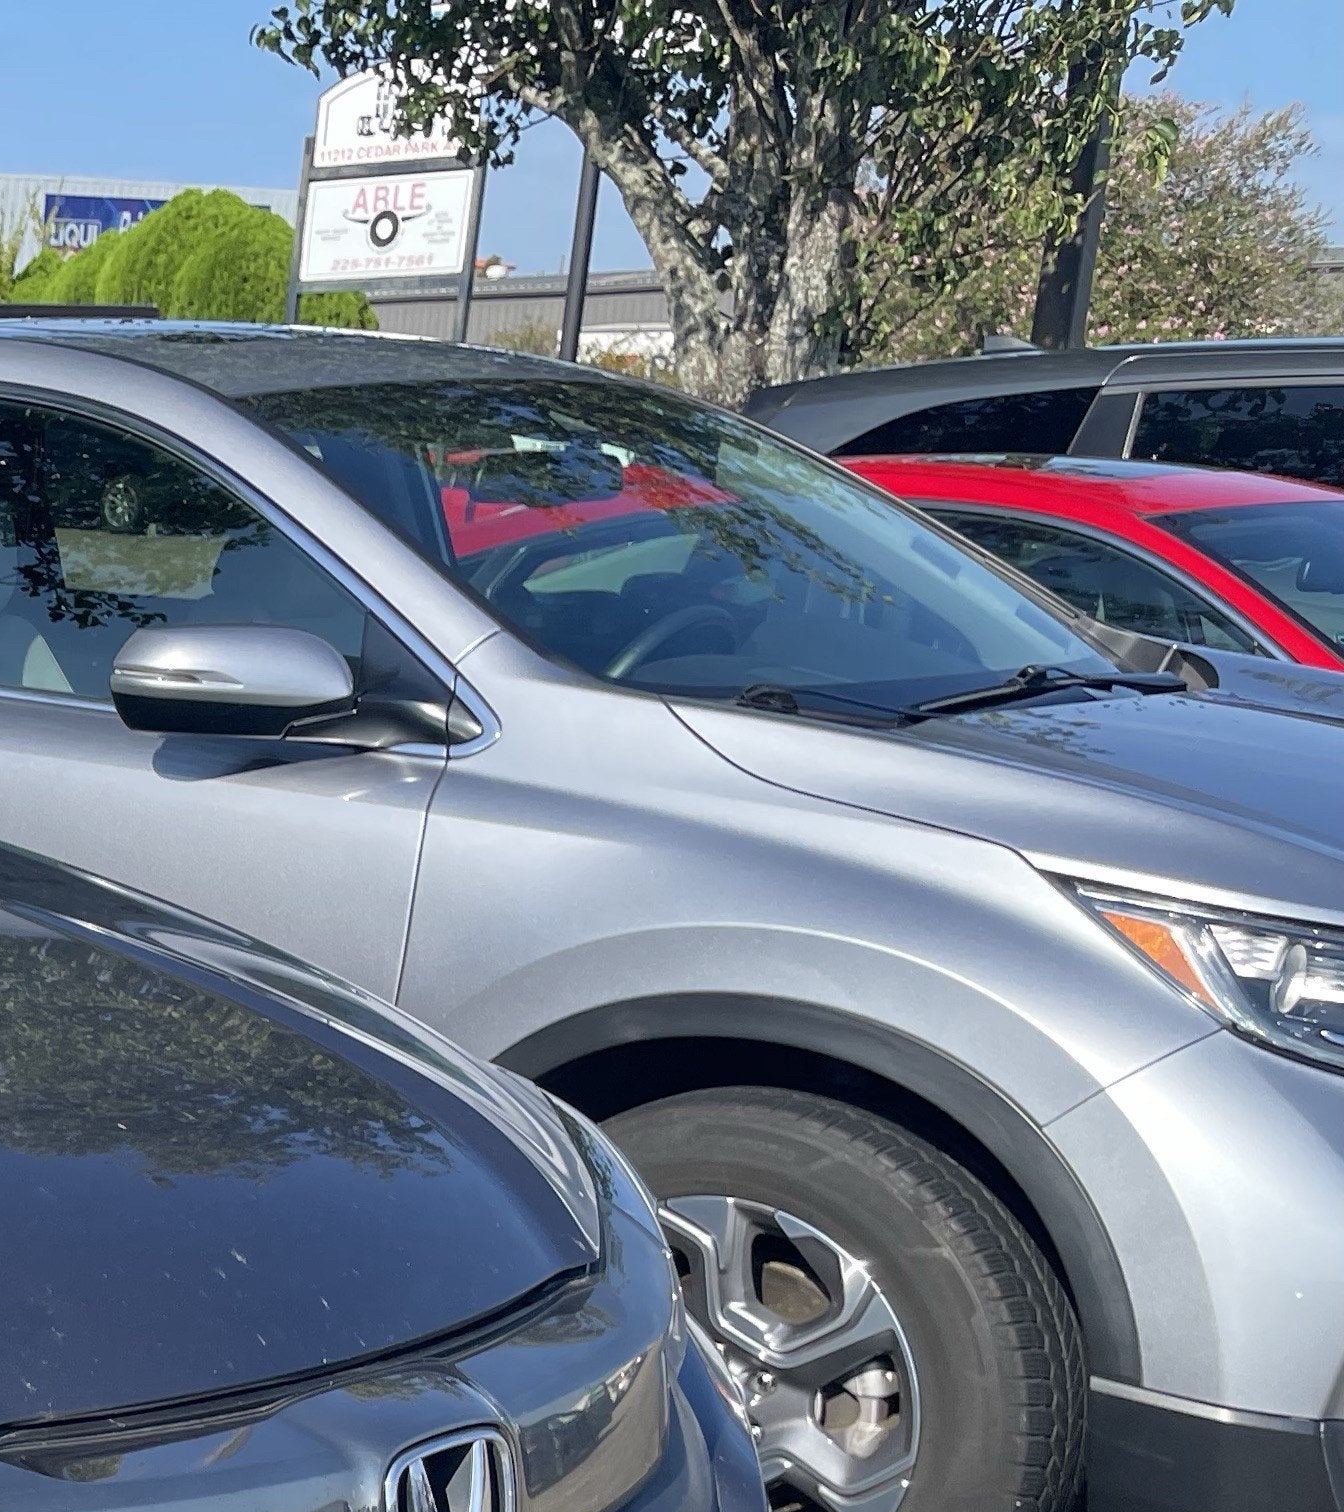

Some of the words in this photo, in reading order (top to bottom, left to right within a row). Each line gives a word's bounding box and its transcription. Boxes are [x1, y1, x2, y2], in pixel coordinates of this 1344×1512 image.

[357, 144, 401, 160] CEDAR
[404, 140, 438, 155] PARK
[351, 181, 427, 214] ABLE
